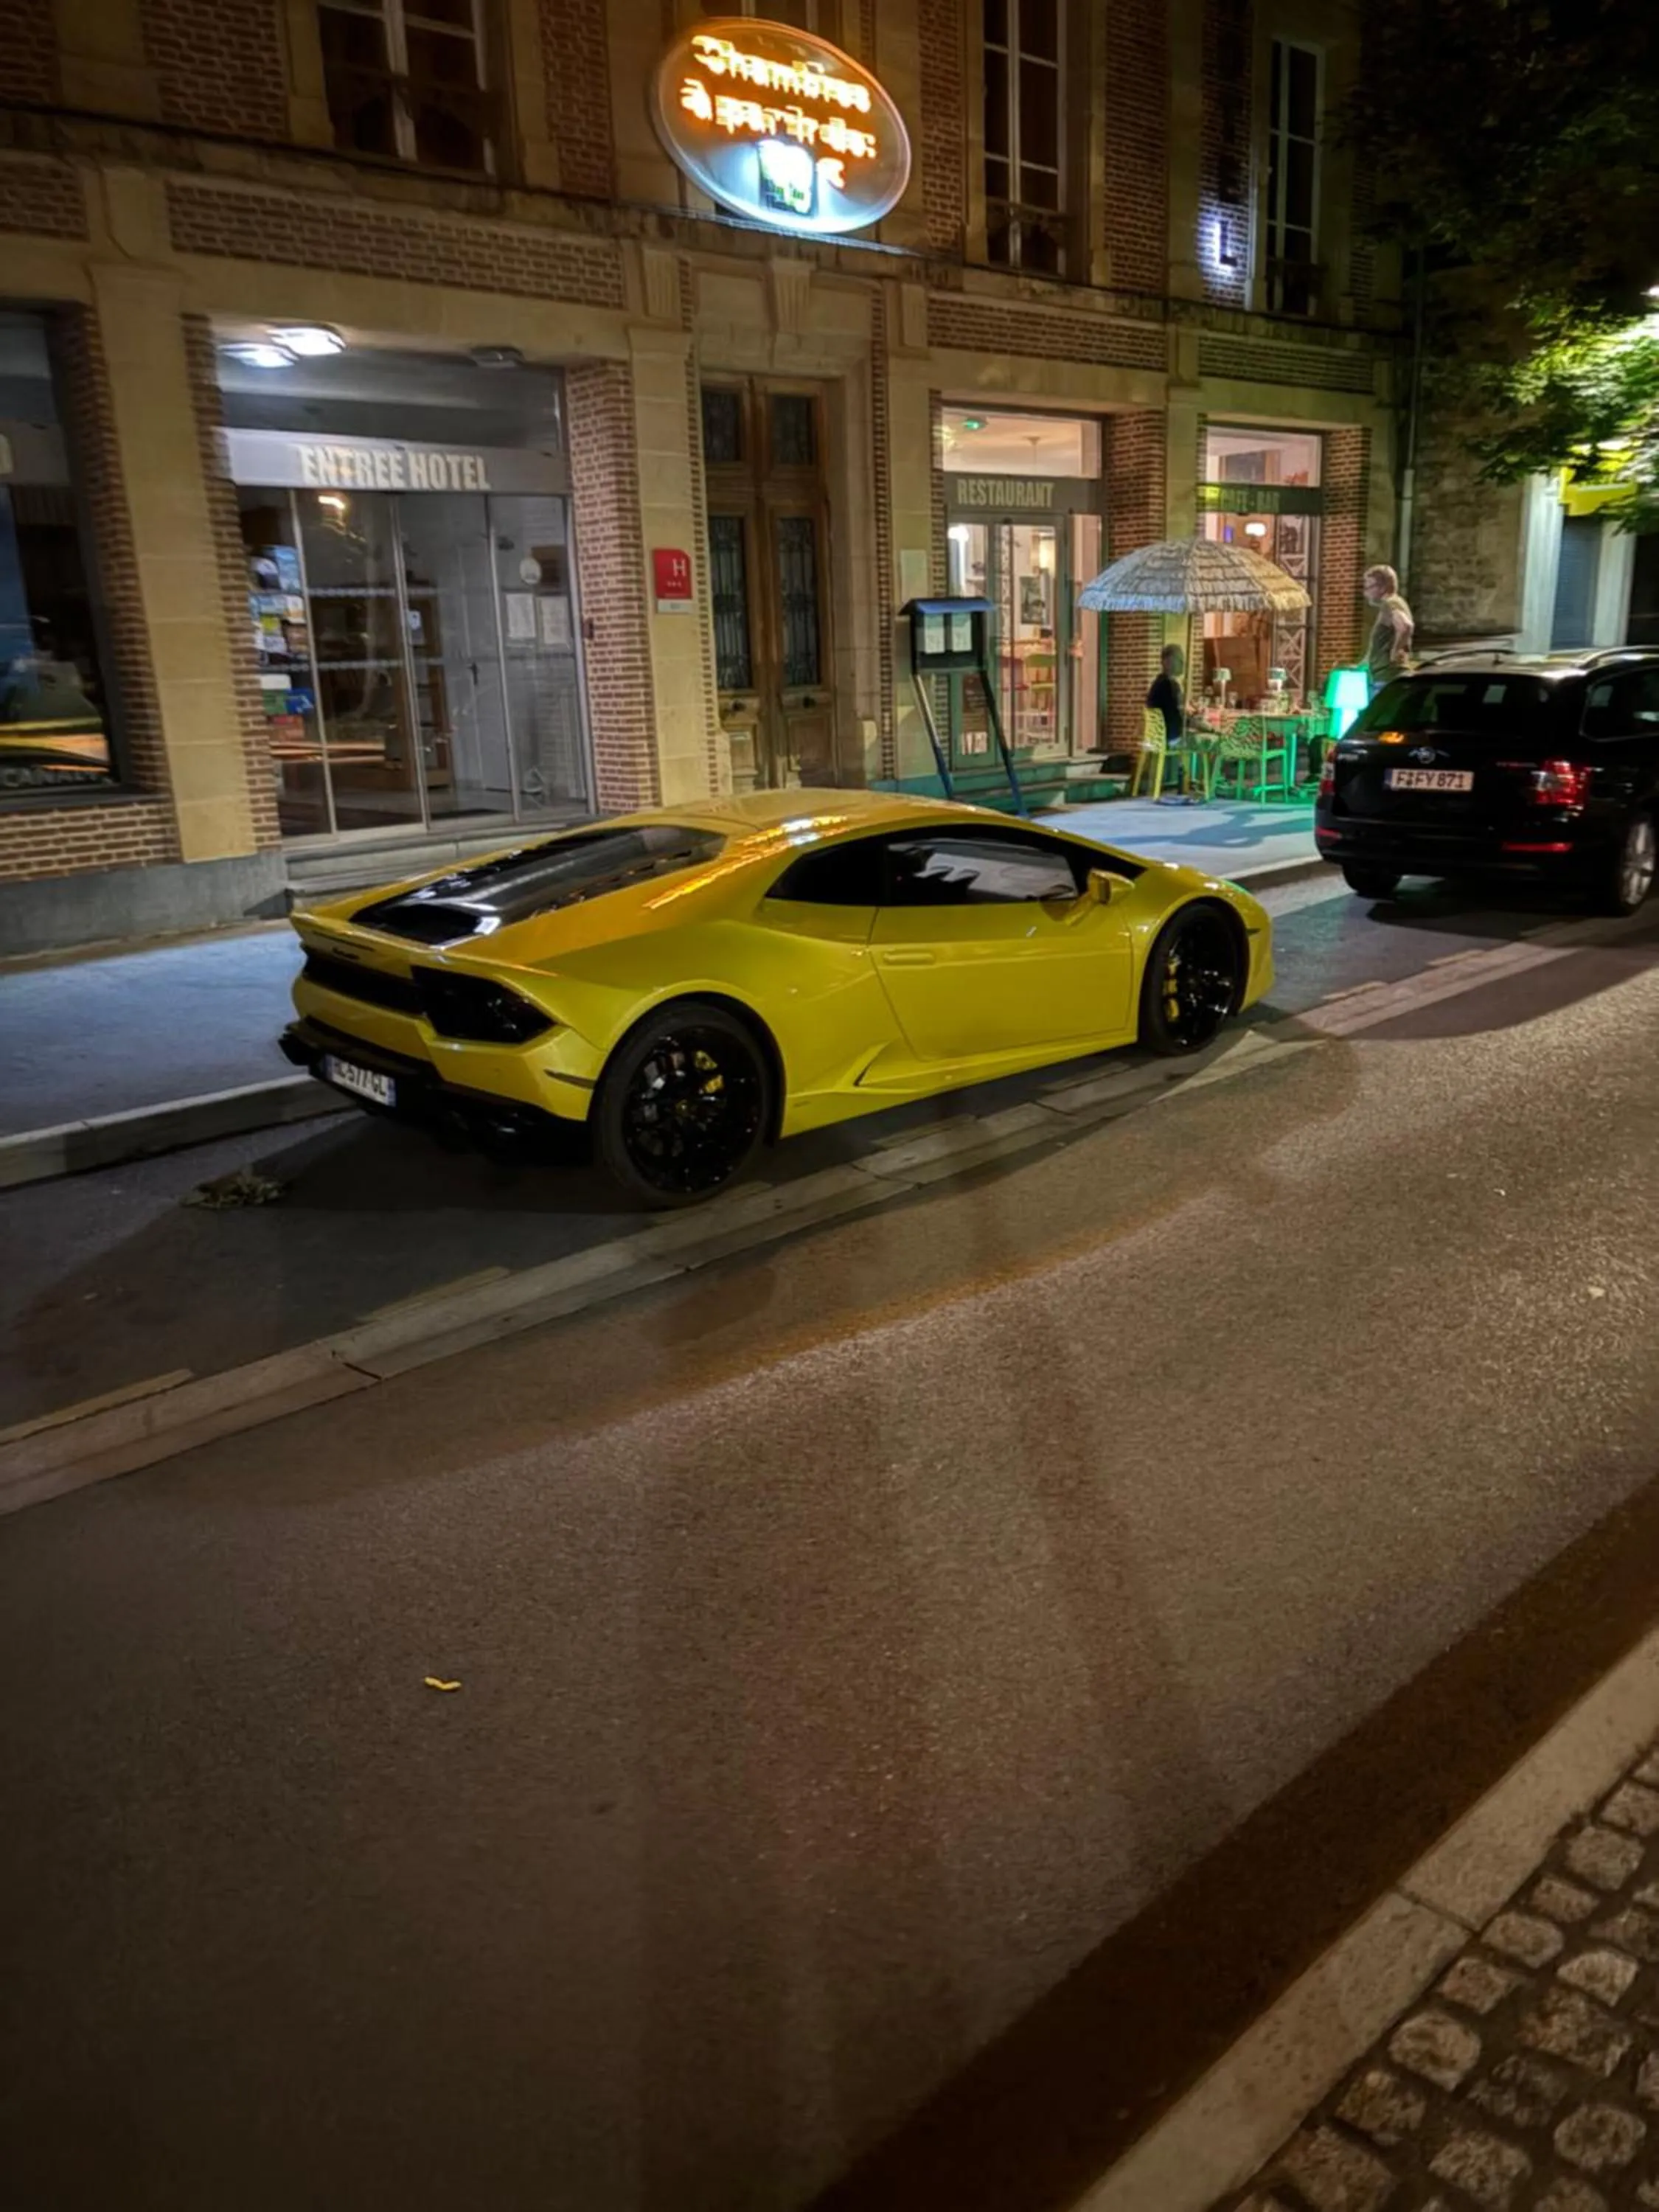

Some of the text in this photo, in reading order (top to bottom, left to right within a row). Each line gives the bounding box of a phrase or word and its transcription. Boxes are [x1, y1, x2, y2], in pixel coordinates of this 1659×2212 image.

[301, 445, 492, 490] ENTREE HOTEL
[957, 479, 1056, 508] RESTAURANT
[672, 557, 686, 577] H
